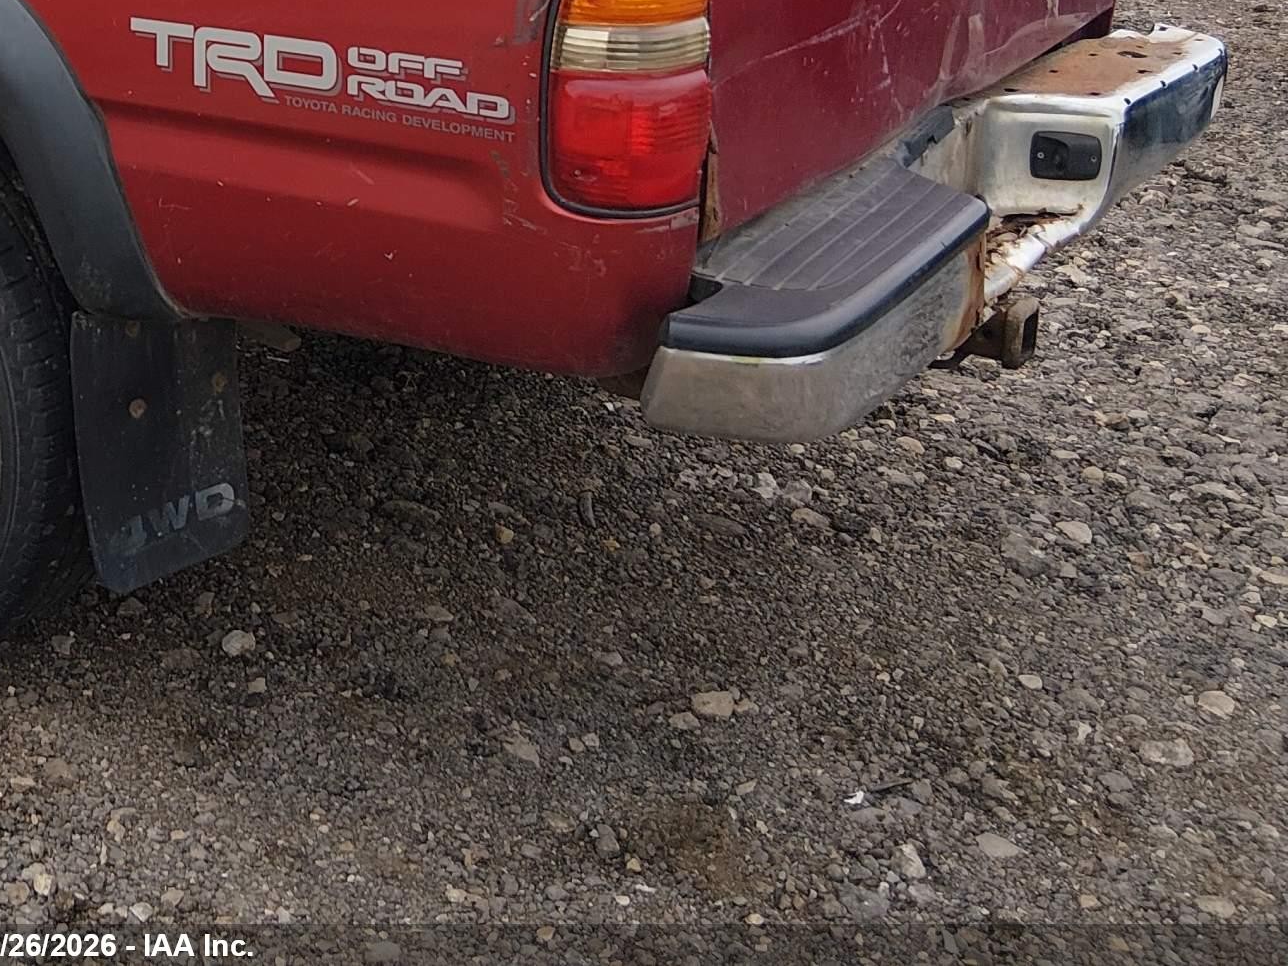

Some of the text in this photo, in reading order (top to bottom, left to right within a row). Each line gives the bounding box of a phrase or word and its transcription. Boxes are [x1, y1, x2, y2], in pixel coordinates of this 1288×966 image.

[129, 16, 469, 104] TRD OFF
[284, 94, 516, 143] TOYOTA RACING DEVELOPMENT
[346, 74, 515, 124] ROAD
[108, 482, 236, 558] 4WD
